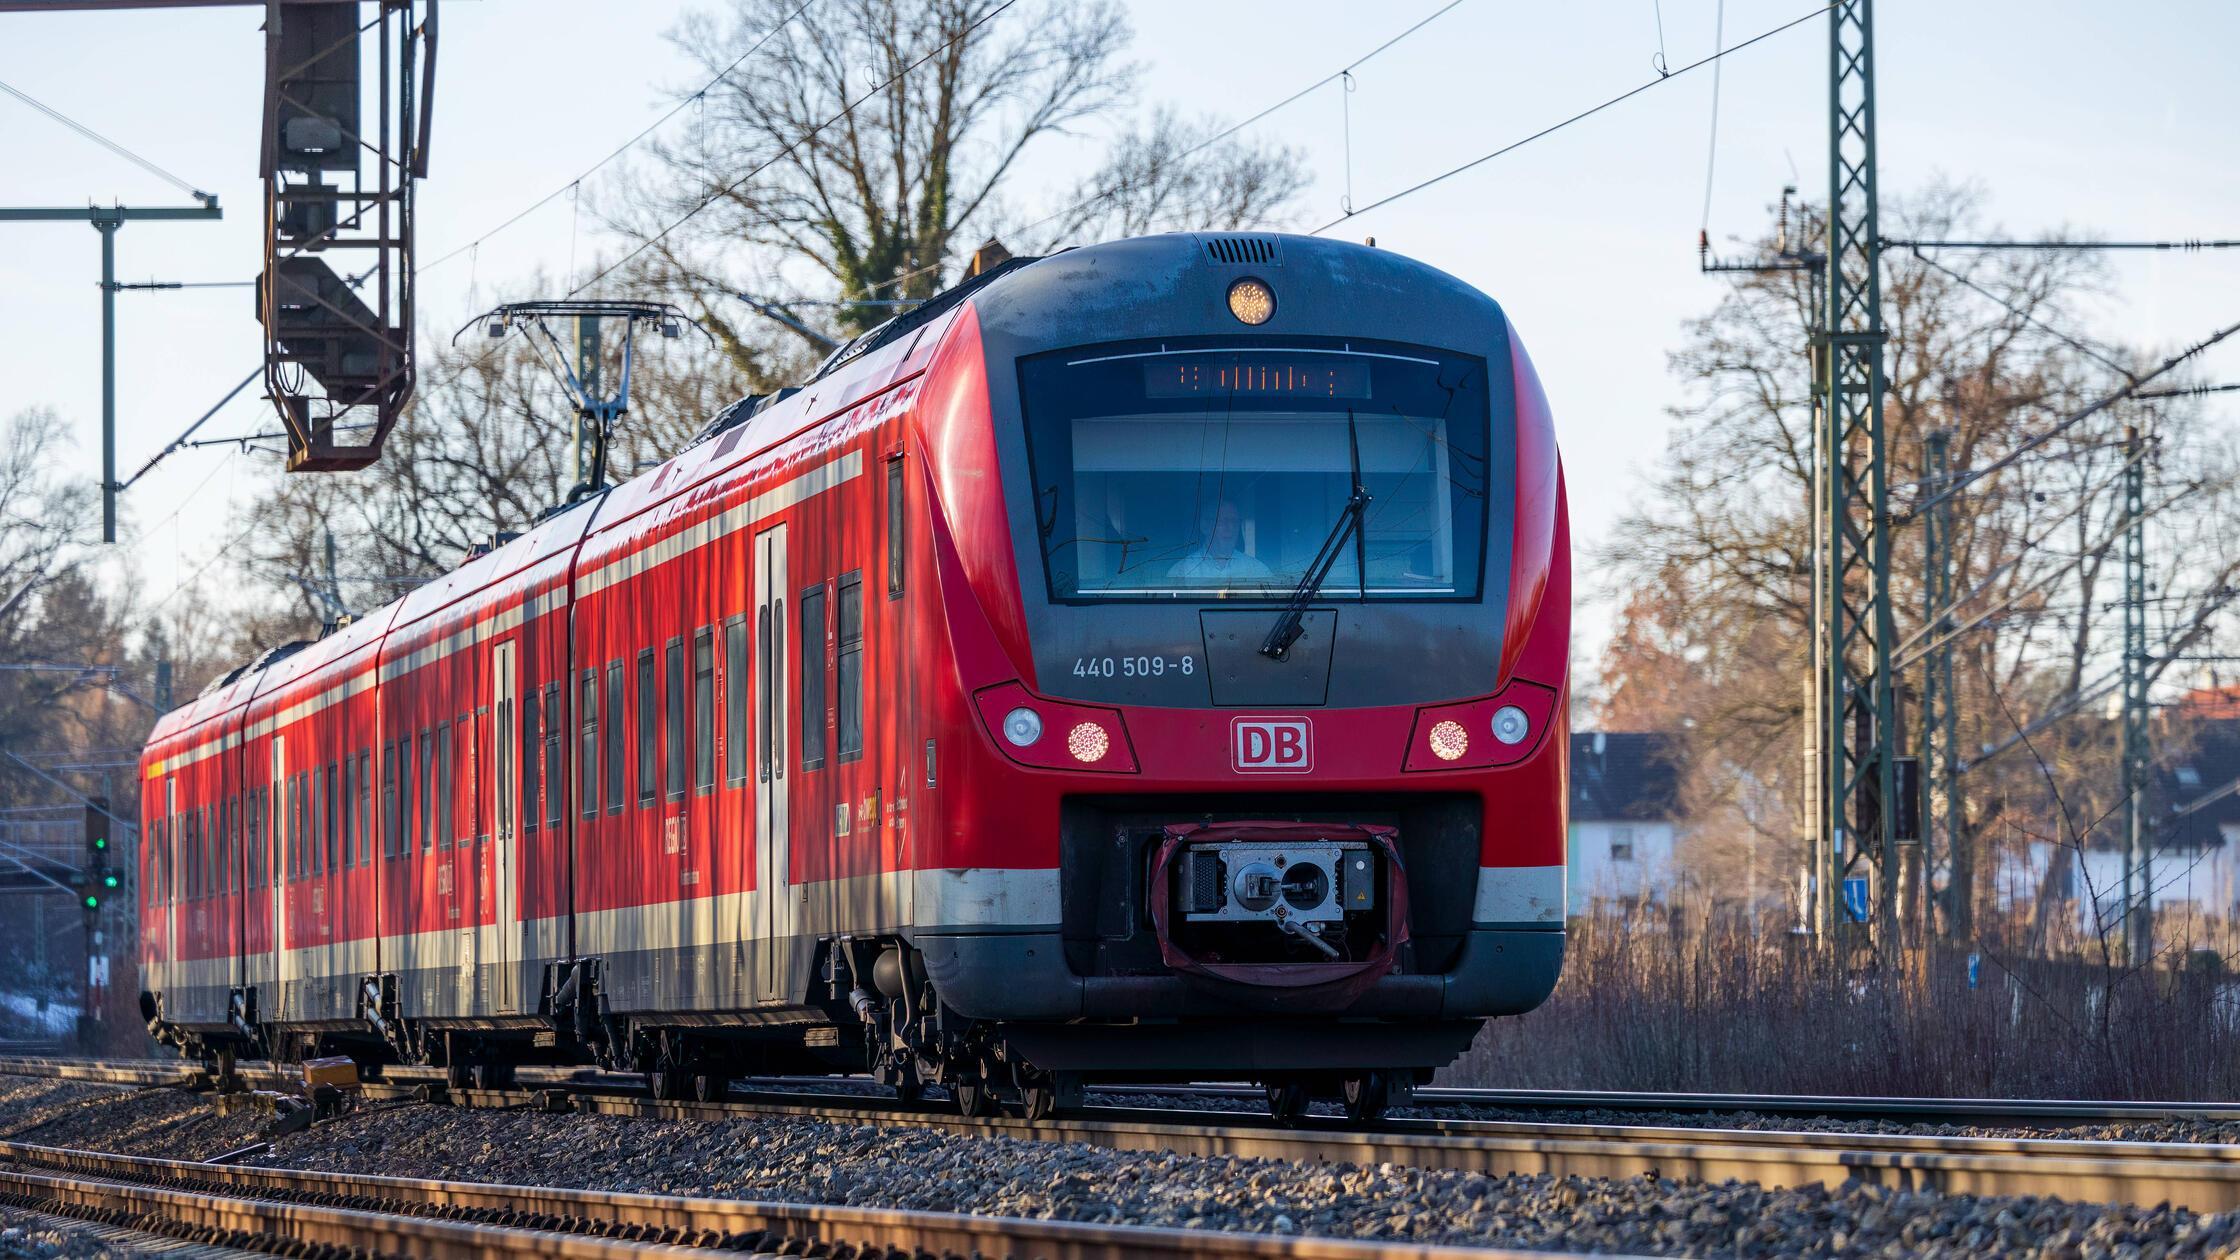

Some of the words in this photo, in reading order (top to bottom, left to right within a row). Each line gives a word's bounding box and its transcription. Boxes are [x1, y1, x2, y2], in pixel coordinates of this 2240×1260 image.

[1073, 657, 1115, 678] 440
[1123, 655, 1194, 677] 509-8
[1241, 726, 1304, 764] DB
